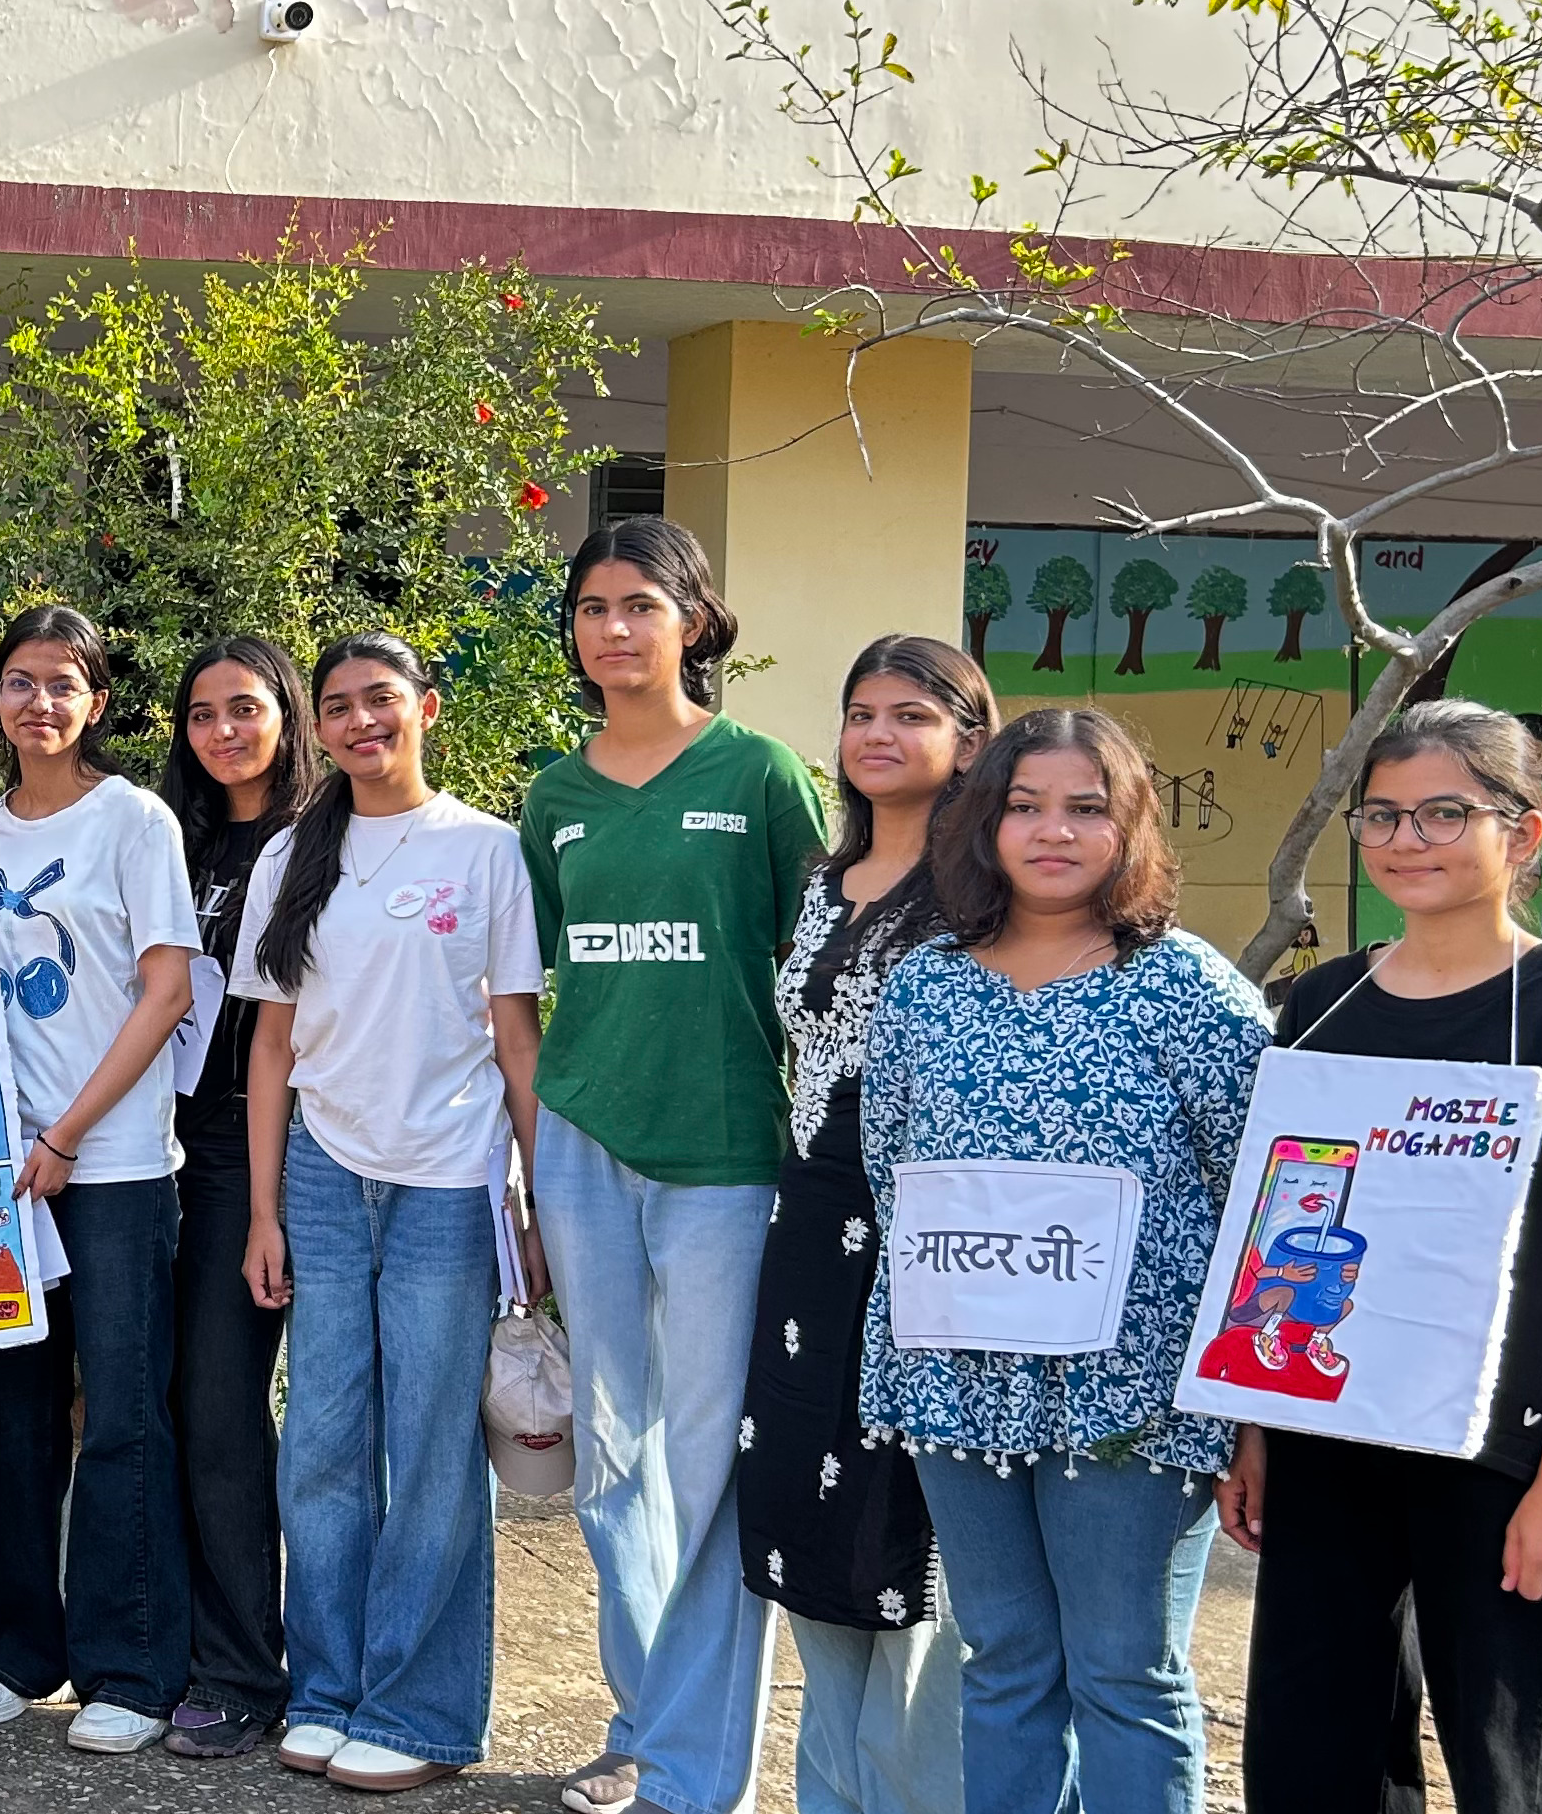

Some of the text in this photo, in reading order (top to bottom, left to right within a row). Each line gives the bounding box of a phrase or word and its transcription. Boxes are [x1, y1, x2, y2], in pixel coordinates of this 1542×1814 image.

[1375, 544, 1424, 572] and
[707, 811, 748, 834] DIESEL
[619, 921, 706, 962] DIESEL
[1404, 1096, 1519, 1126] MOBILE
[916, 1224, 1083, 1282] मास्टर जी
